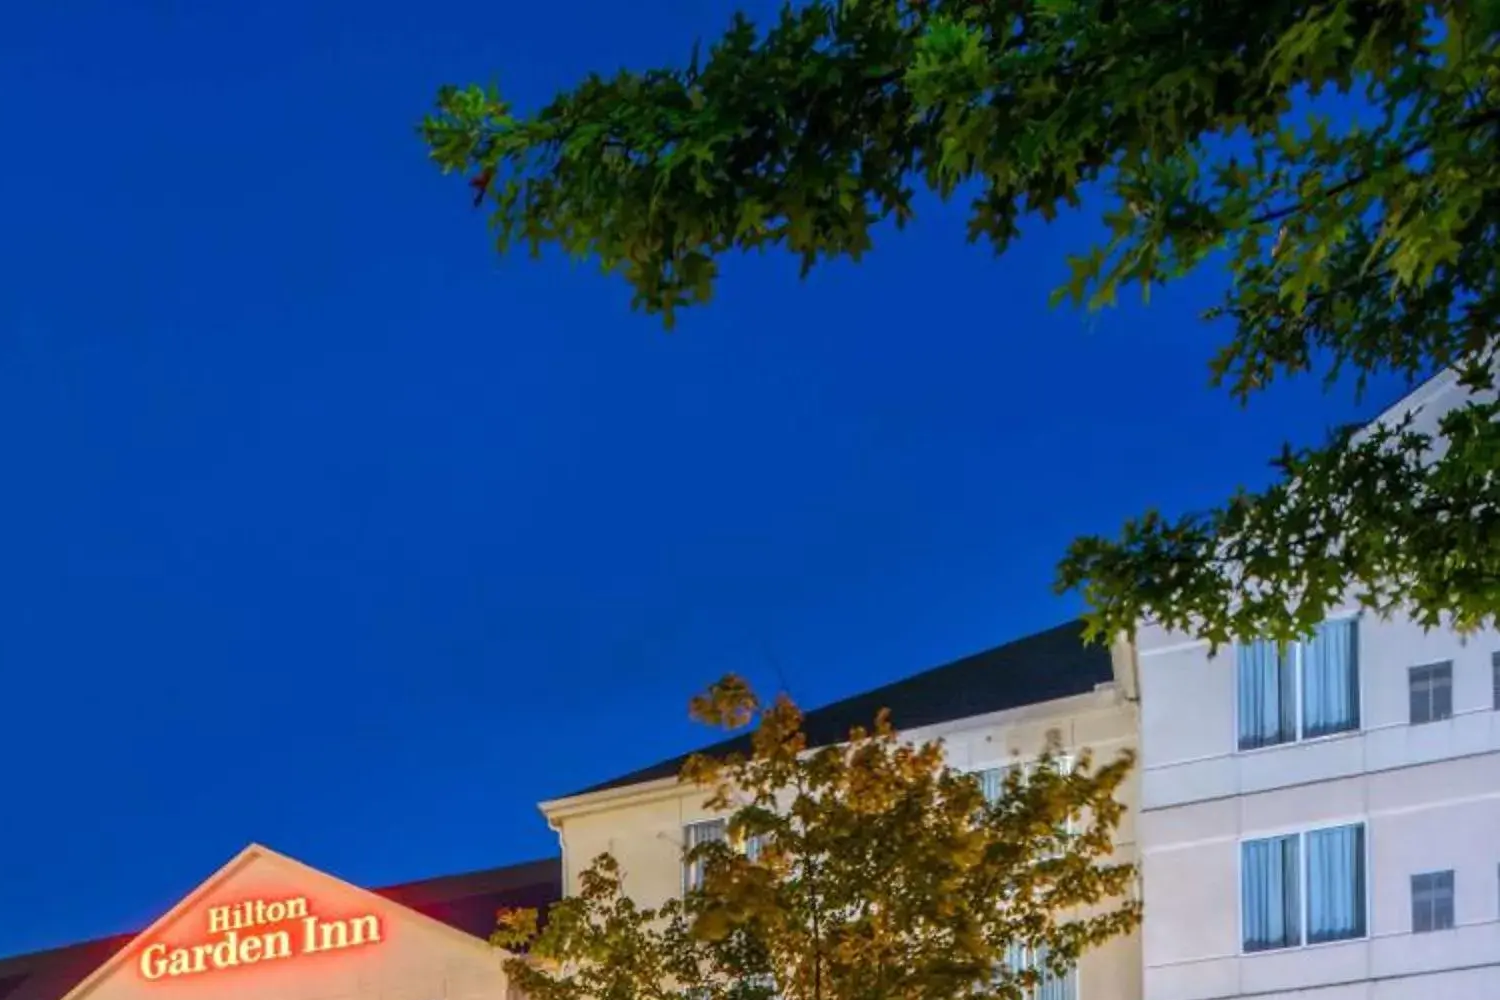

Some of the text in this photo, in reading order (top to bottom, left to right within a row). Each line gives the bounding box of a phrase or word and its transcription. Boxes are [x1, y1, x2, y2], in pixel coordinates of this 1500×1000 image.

[209, 897, 308, 933] Hilton
[140, 914, 380, 979] Garden Inn
